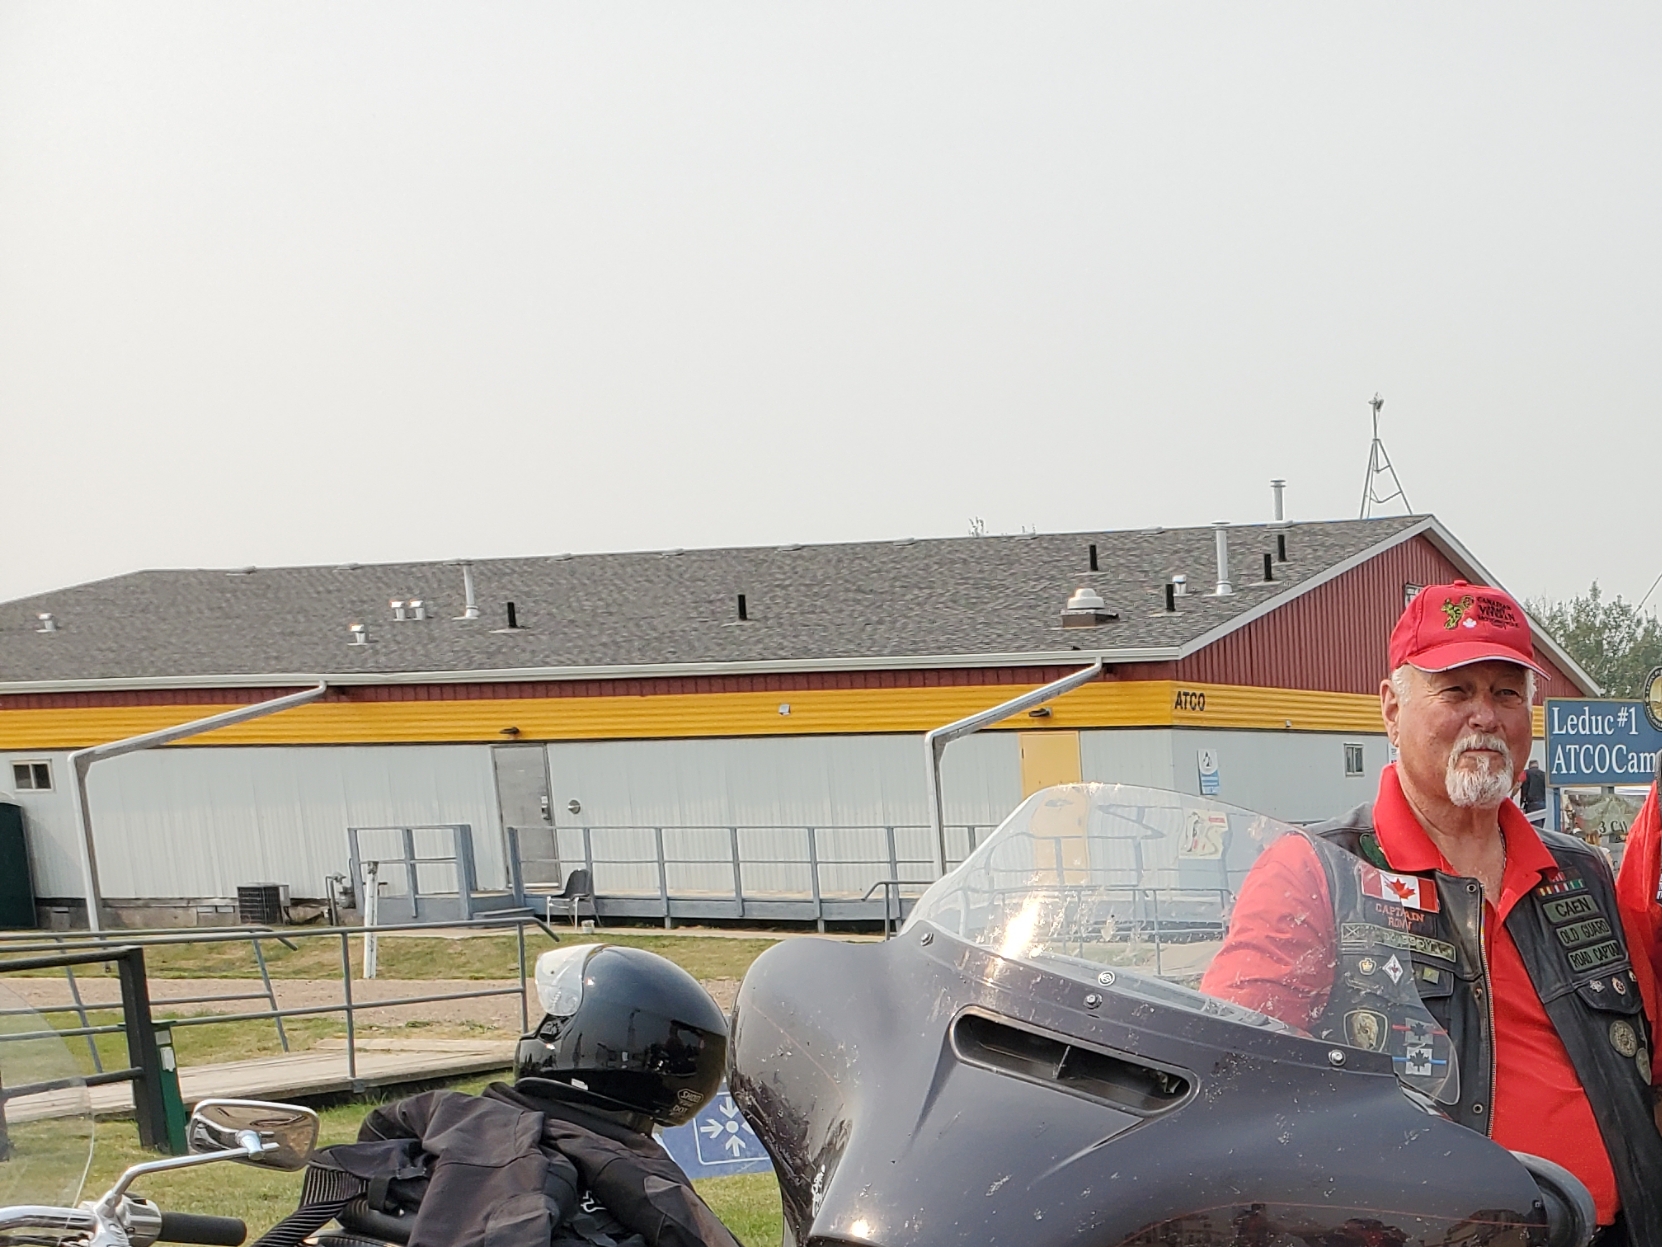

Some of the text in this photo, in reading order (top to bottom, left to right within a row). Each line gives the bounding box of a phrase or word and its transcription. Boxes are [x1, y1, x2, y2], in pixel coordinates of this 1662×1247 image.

[1174, 690, 1206, 712] ATCO
[1551, 706, 1615, 736] Leduc
[1617, 706, 1639, 735] #1
[1555, 897, 1592, 918] CAEN
[1560, 920, 1610, 944] OLD GUARD
[1569, 949, 1592, 968] ROAD
